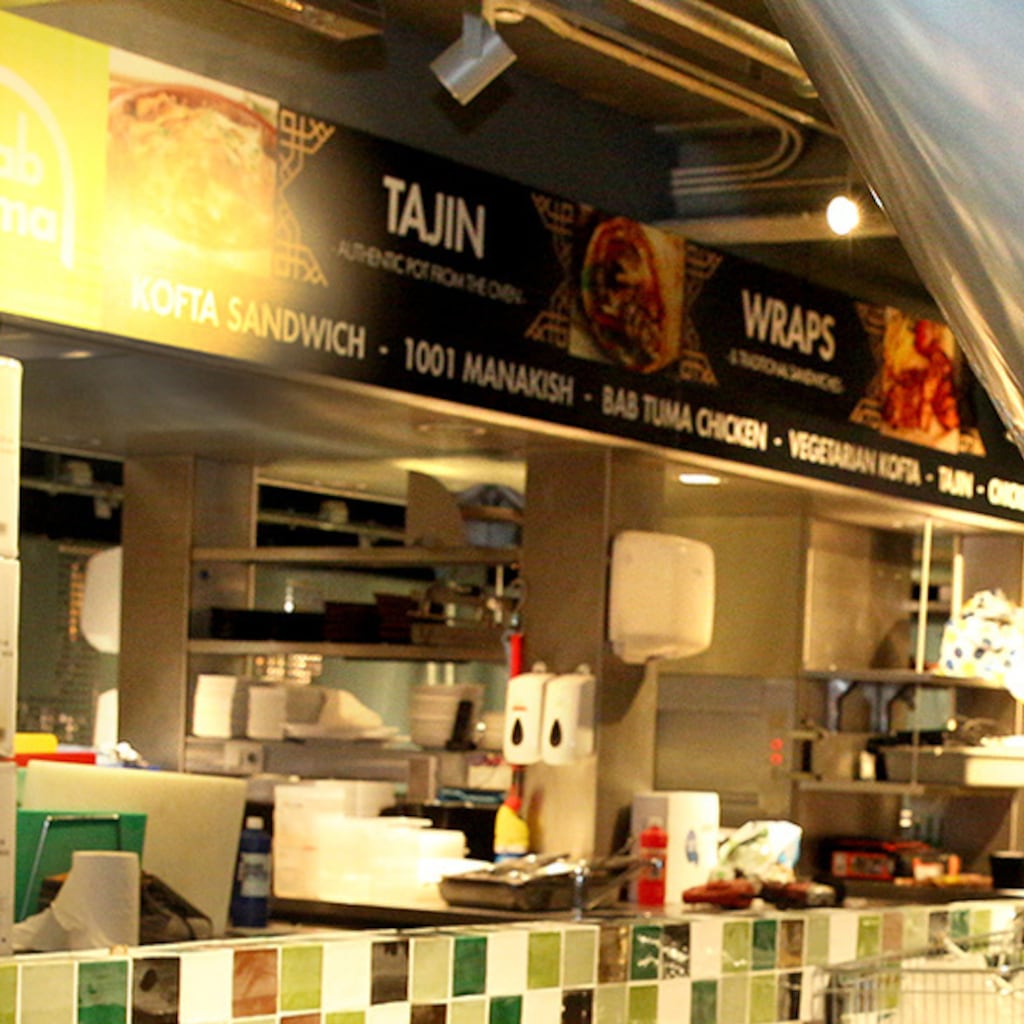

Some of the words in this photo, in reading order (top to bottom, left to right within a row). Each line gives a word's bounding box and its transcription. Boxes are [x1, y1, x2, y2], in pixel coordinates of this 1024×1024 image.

[383, 175, 486, 260] TAJIN
[741, 289, 836, 362] WRAPS
[132, 276, 220, 328] KOFTA
[226, 296, 367, 360] SANDWICH
[404, 336, 456, 380] 1001
[462, 351, 575, 406] MANAKISH
[602, 384, 640, 421] BAB
[641, 394, 694, 434] TUMA
[695, 407, 769, 451] CHICKEN
[788, 428, 877, 476] VEGETARIAN
[878, 451, 922, 487] KOFTA
